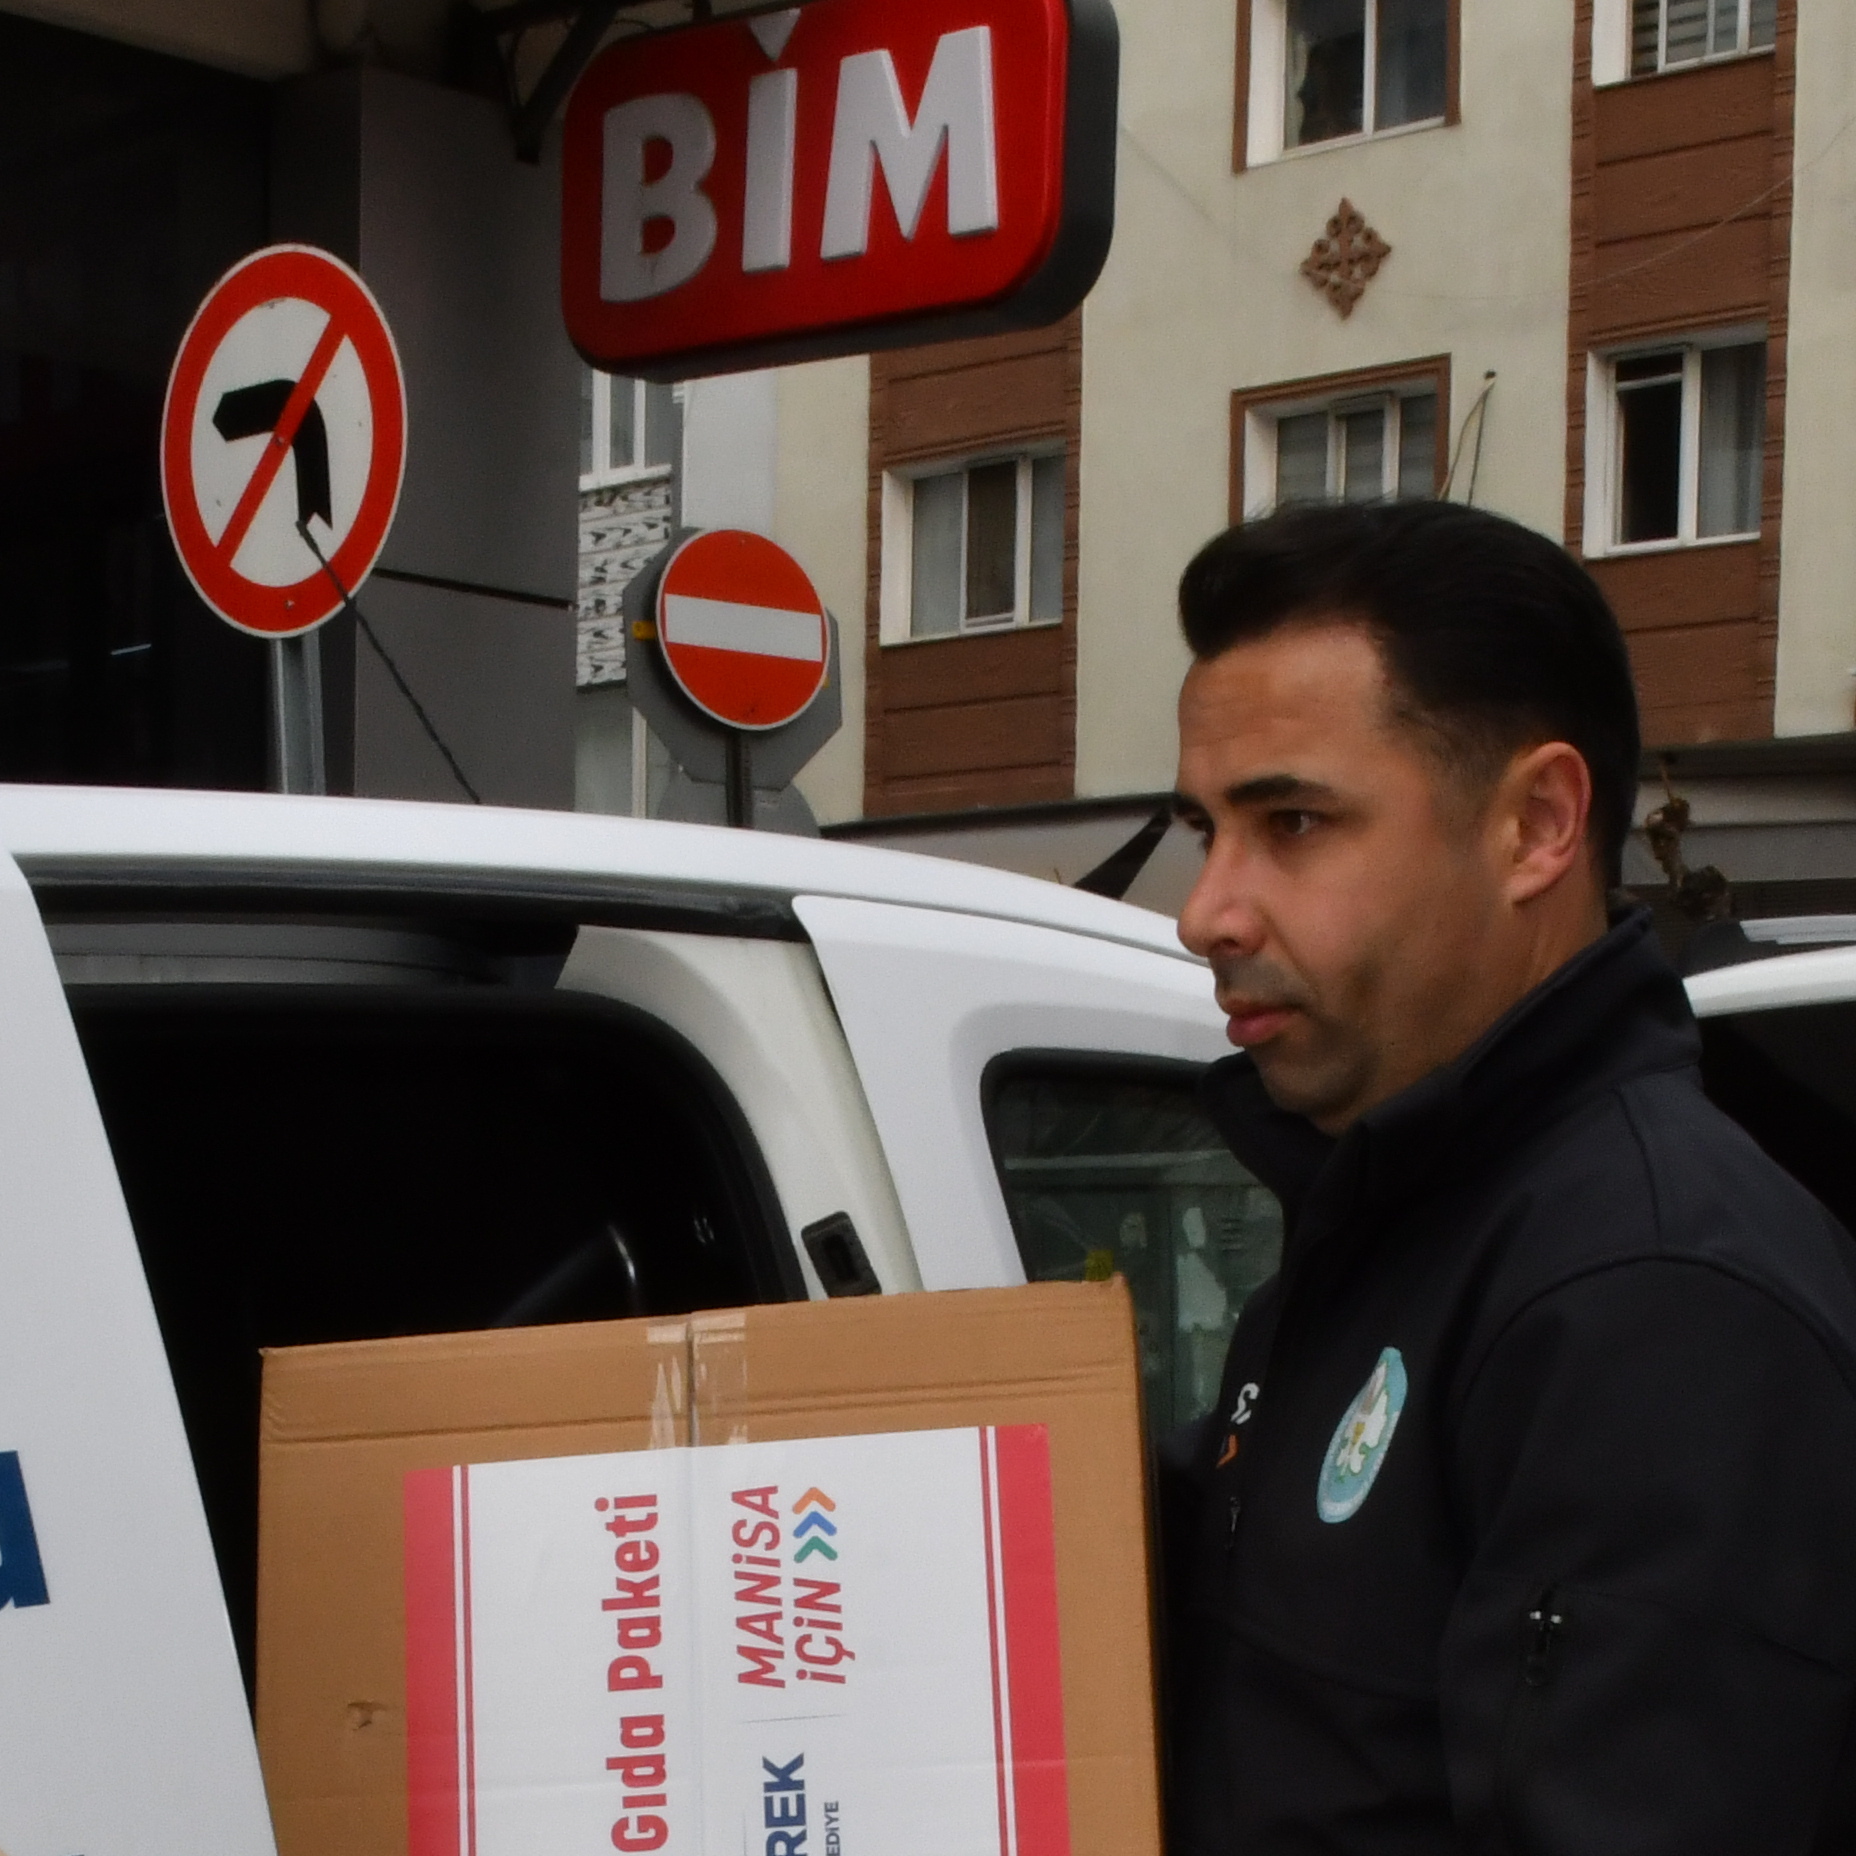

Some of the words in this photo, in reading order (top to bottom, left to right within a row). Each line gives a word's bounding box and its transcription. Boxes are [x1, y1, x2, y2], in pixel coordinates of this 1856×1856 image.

[600, 8, 999, 302] BİM
[594, 1493, 664, 1692] Paketi
[606, 1714, 670, 1852] Gıda
